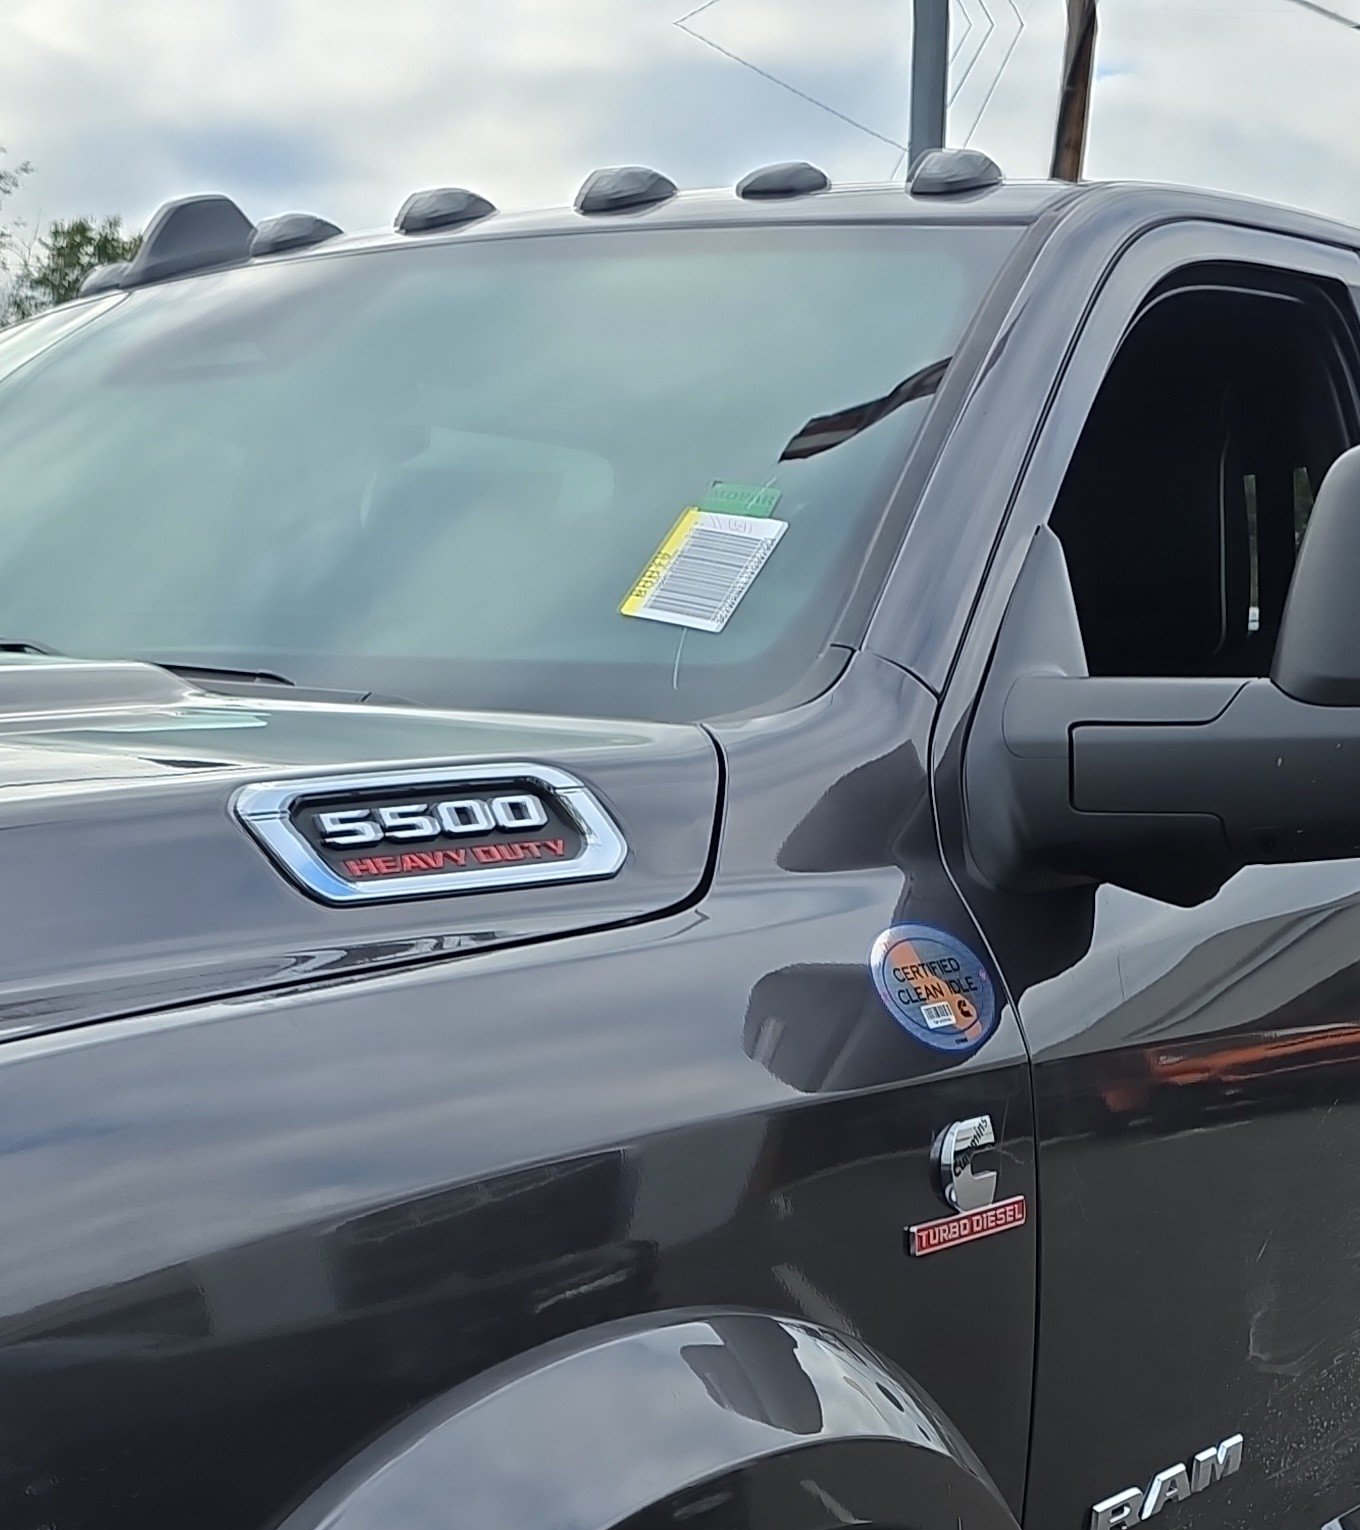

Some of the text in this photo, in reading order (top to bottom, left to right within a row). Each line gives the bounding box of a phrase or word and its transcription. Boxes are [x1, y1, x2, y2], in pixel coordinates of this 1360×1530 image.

[316, 794, 549, 847] 5500
[342, 838, 567, 878] HEAVY DUTY
[892, 957, 960, 982] CERTIFIED
[897, 975, 979, 1005] CLEAN IDLE
[917, 1203, 1023, 1249] TURBO DIESEL
